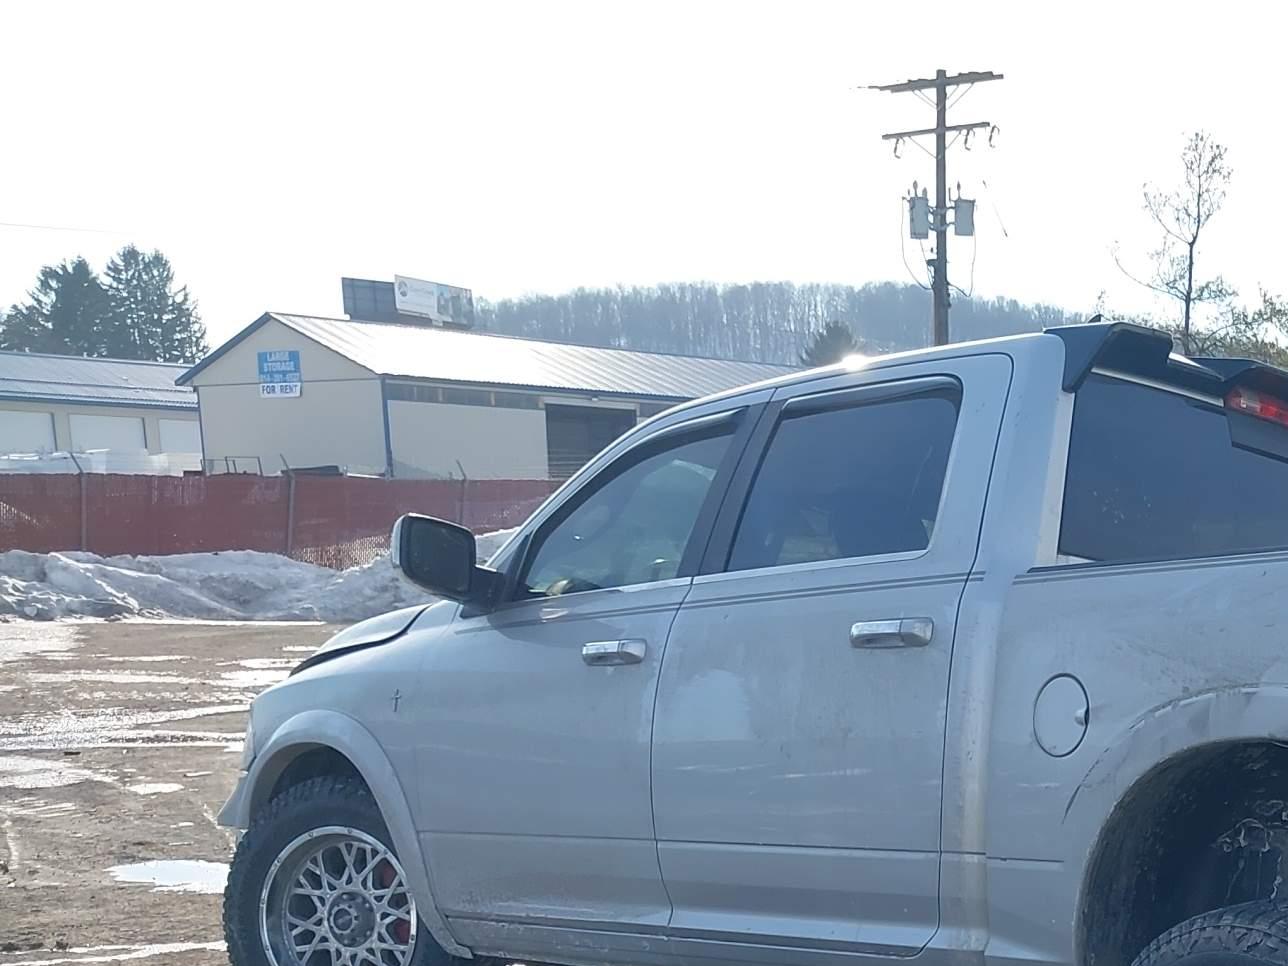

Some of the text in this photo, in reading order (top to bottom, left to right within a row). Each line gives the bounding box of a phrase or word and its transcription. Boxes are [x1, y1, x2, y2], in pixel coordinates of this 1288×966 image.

[264, 361, 295, 372] STORAGE
[261, 384, 298, 394] FOR RENT
